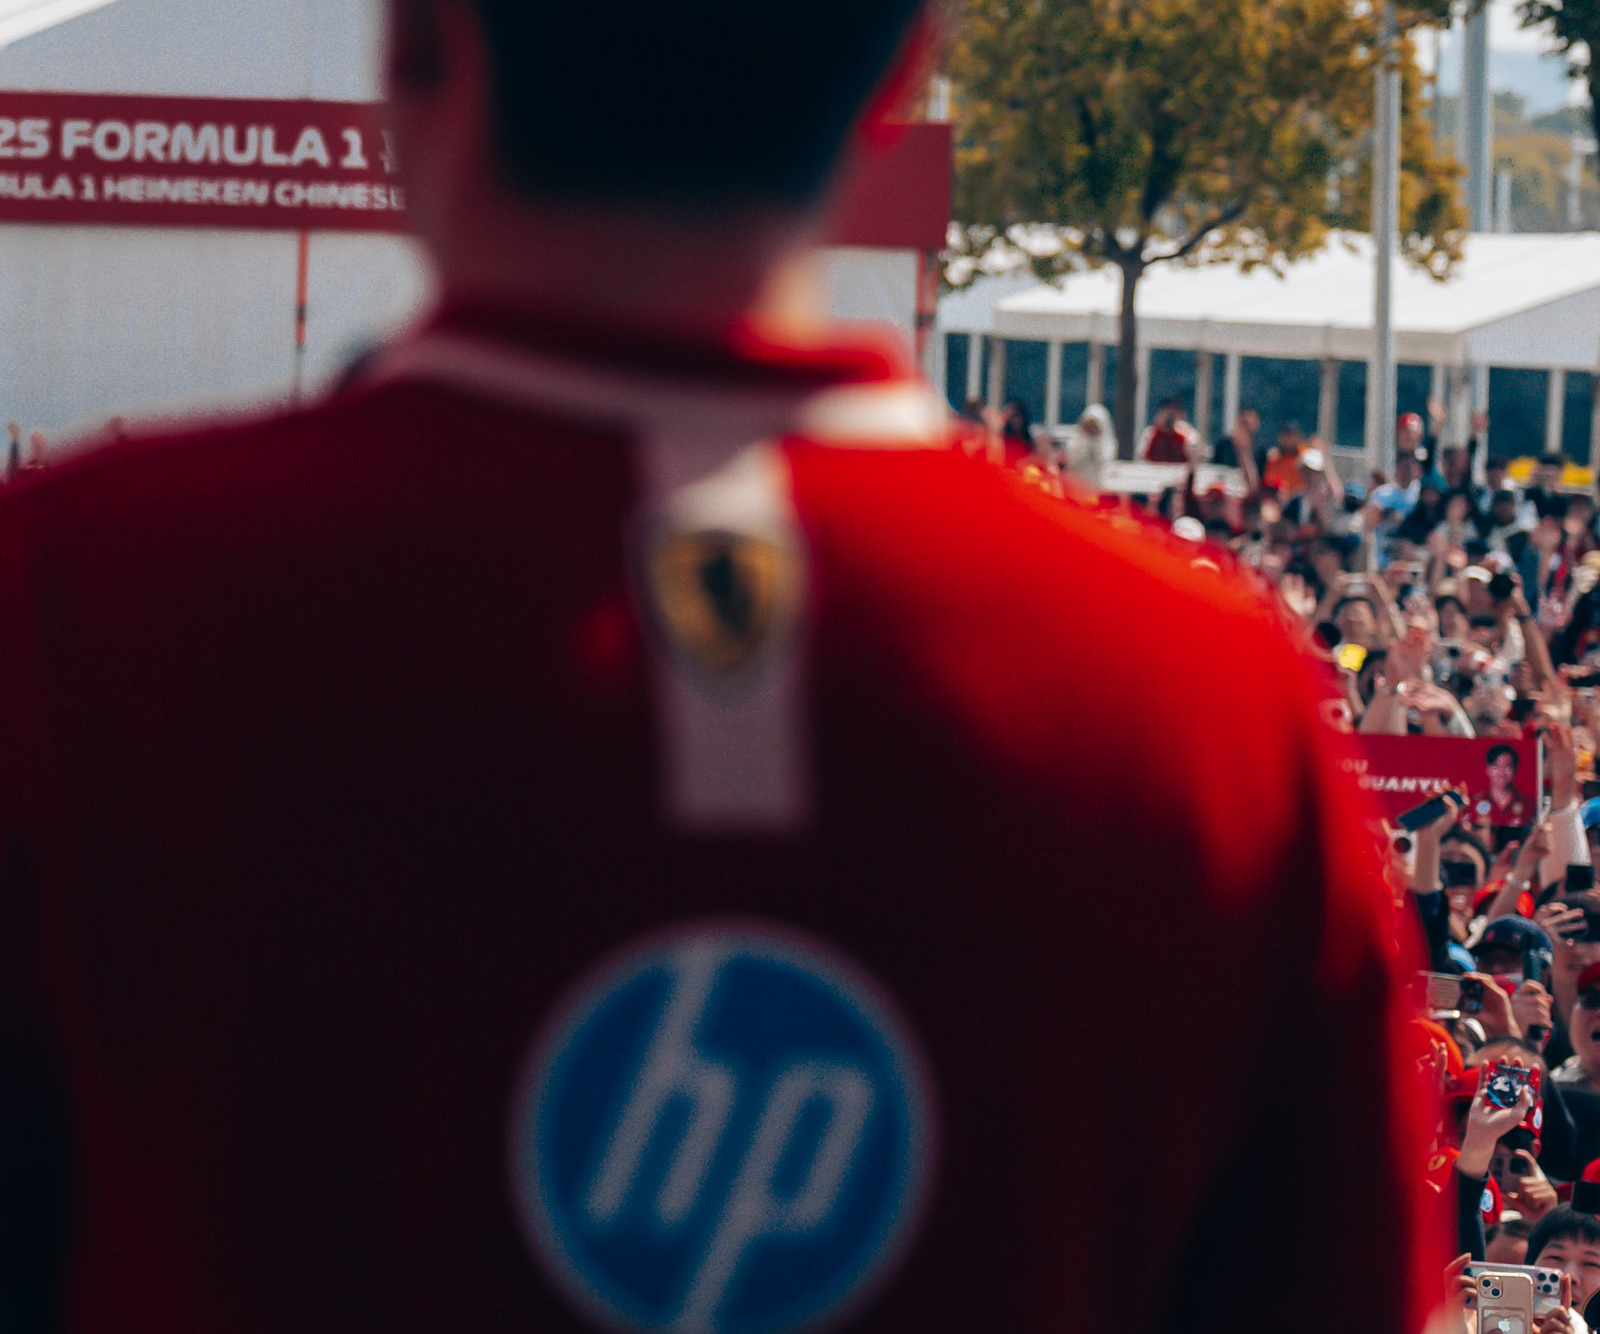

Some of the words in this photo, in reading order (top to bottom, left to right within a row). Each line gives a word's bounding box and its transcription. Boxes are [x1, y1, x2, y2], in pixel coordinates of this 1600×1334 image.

[61, 121, 328, 167] FORMULA
[341, 128, 367, 169] 1
[82, 176, 96, 200] 1
[104, 178, 268, 205] HEINEKEN
